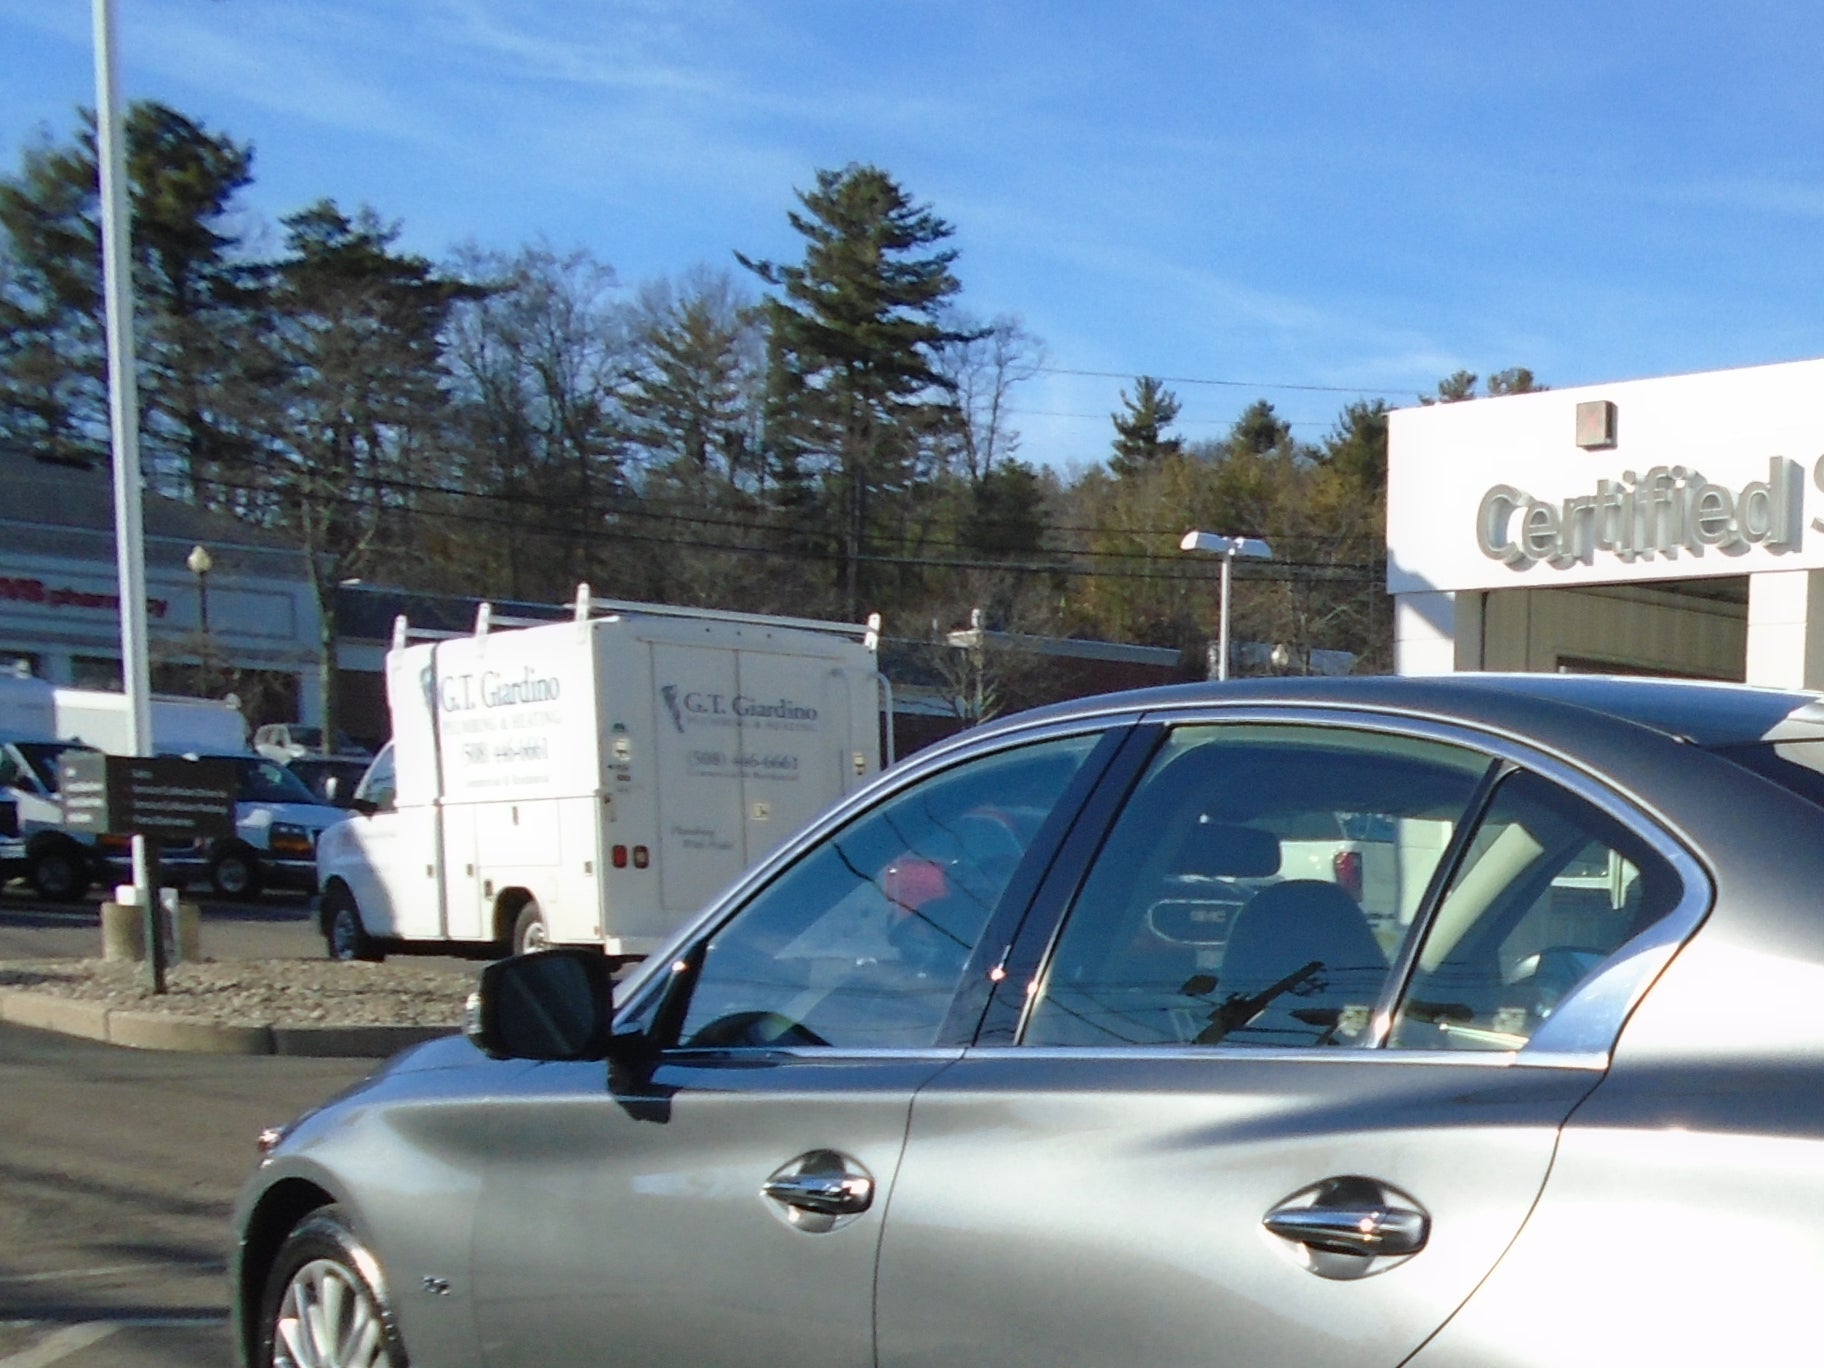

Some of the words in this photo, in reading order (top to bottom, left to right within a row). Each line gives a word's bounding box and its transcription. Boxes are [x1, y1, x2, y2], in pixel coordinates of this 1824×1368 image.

[1476, 454, 1802, 568] Certified
[480, 665, 561, 708] Giardino
[684, 692, 727, 715] G.T.
[731, 694, 818, 721] Giardino
